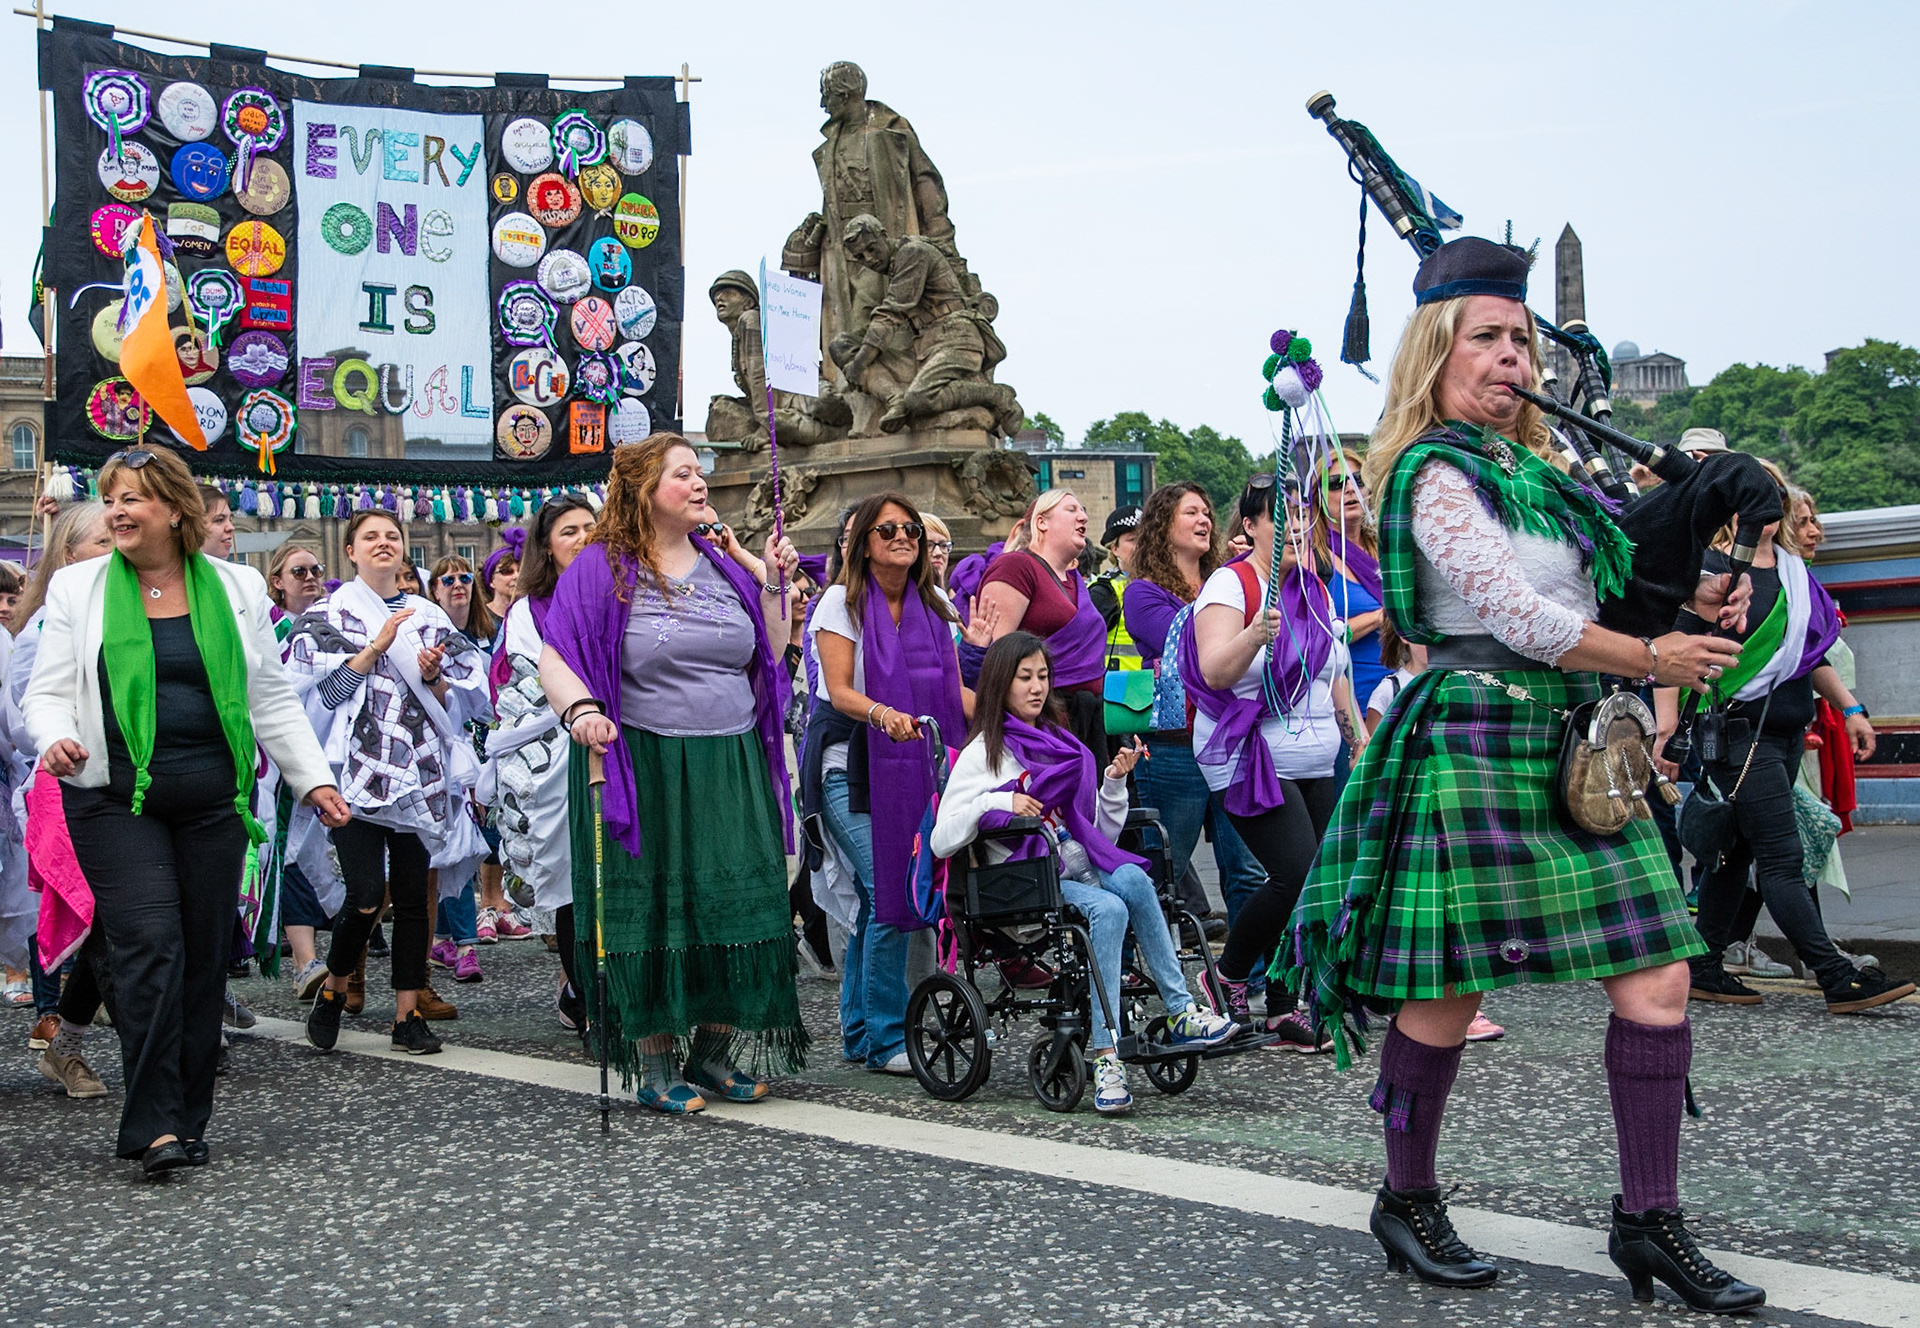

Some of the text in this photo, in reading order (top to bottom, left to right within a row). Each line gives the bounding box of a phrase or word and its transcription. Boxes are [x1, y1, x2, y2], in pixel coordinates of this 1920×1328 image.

[306, 122, 482, 187] EVERY
[251, 204, 266, 214] FOR
[620, 200, 657, 218] POWER
[184, 220, 206, 235] FOR
[620, 221, 639, 238] NO
[171, 238, 212, 251] WOMEN
[229, 236, 283, 256] EQUAL
[205, 287, 224, 295] DUMP
[256, 280, 282, 293] MEN
[251, 308, 287, 322] WOMEN
[359, 281, 436, 335] IS
[528, 351, 549, 359] STO
[298, 356, 490, 419] EQUAL
[594, 812, 603, 864] HILLMASTER
